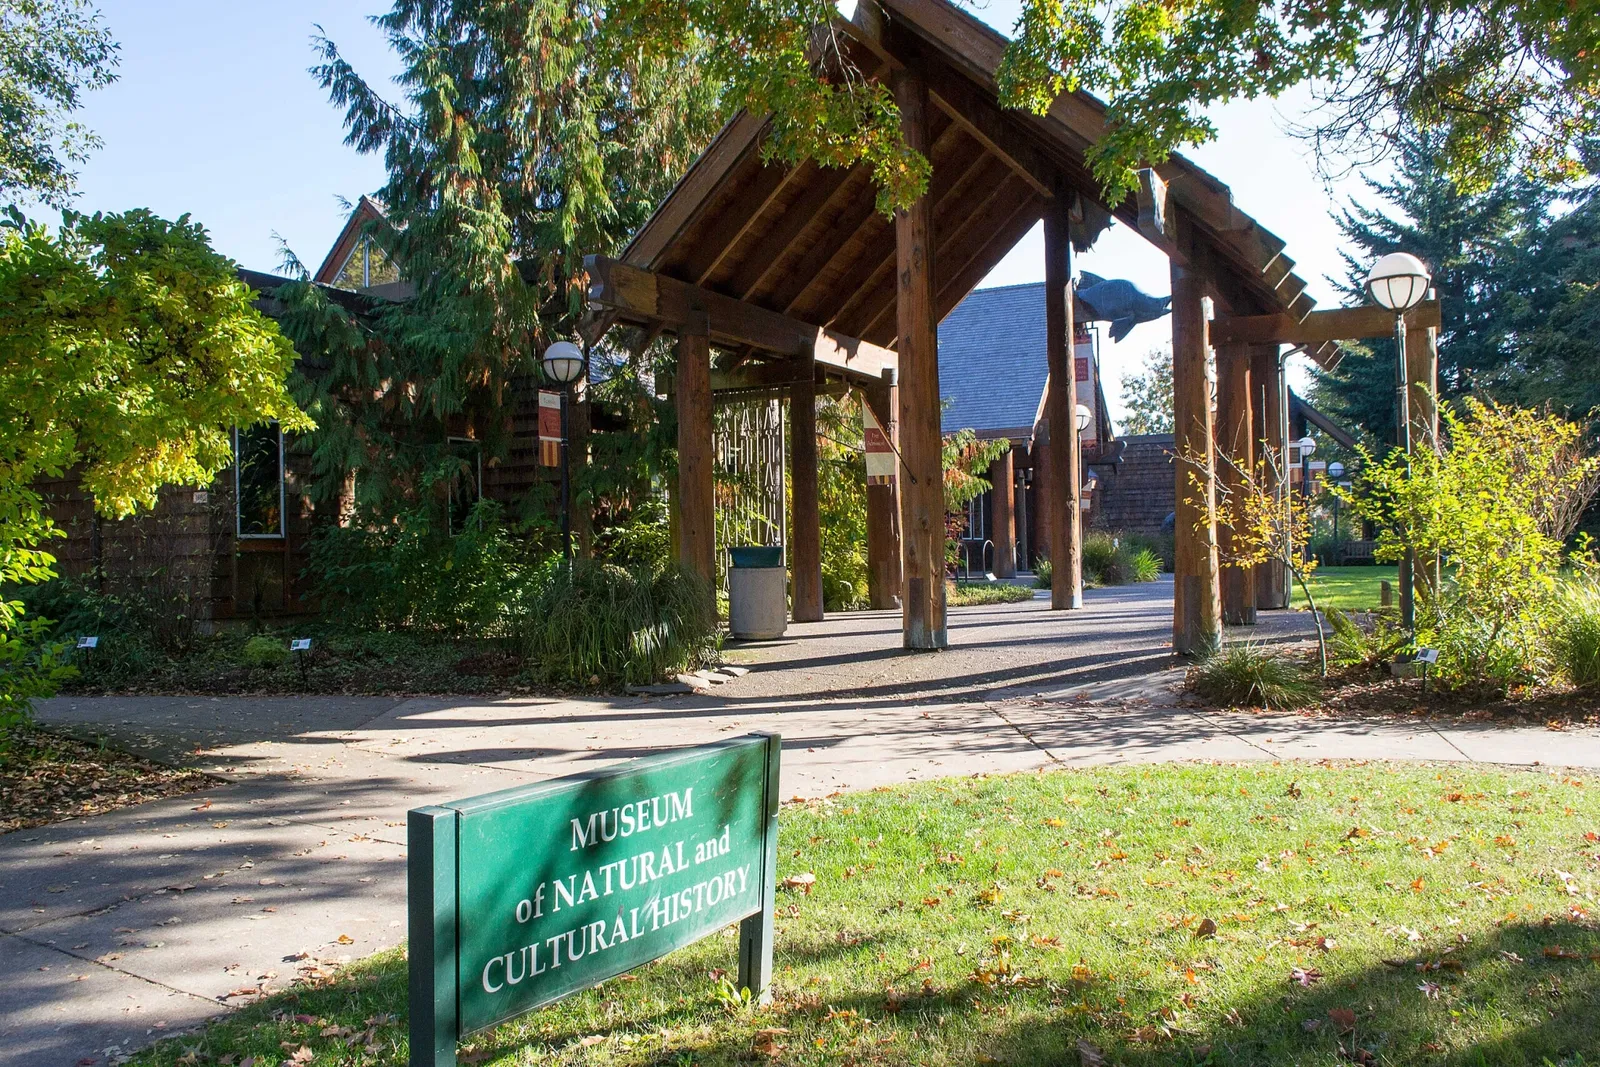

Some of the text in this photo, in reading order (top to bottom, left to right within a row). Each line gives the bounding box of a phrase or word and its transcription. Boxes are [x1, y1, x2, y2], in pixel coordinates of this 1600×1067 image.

[570, 787, 694, 851] MUSEUM
[515, 825, 731, 923] of NATURAL and
[482, 863, 750, 993] CULTURAL HISTORY
